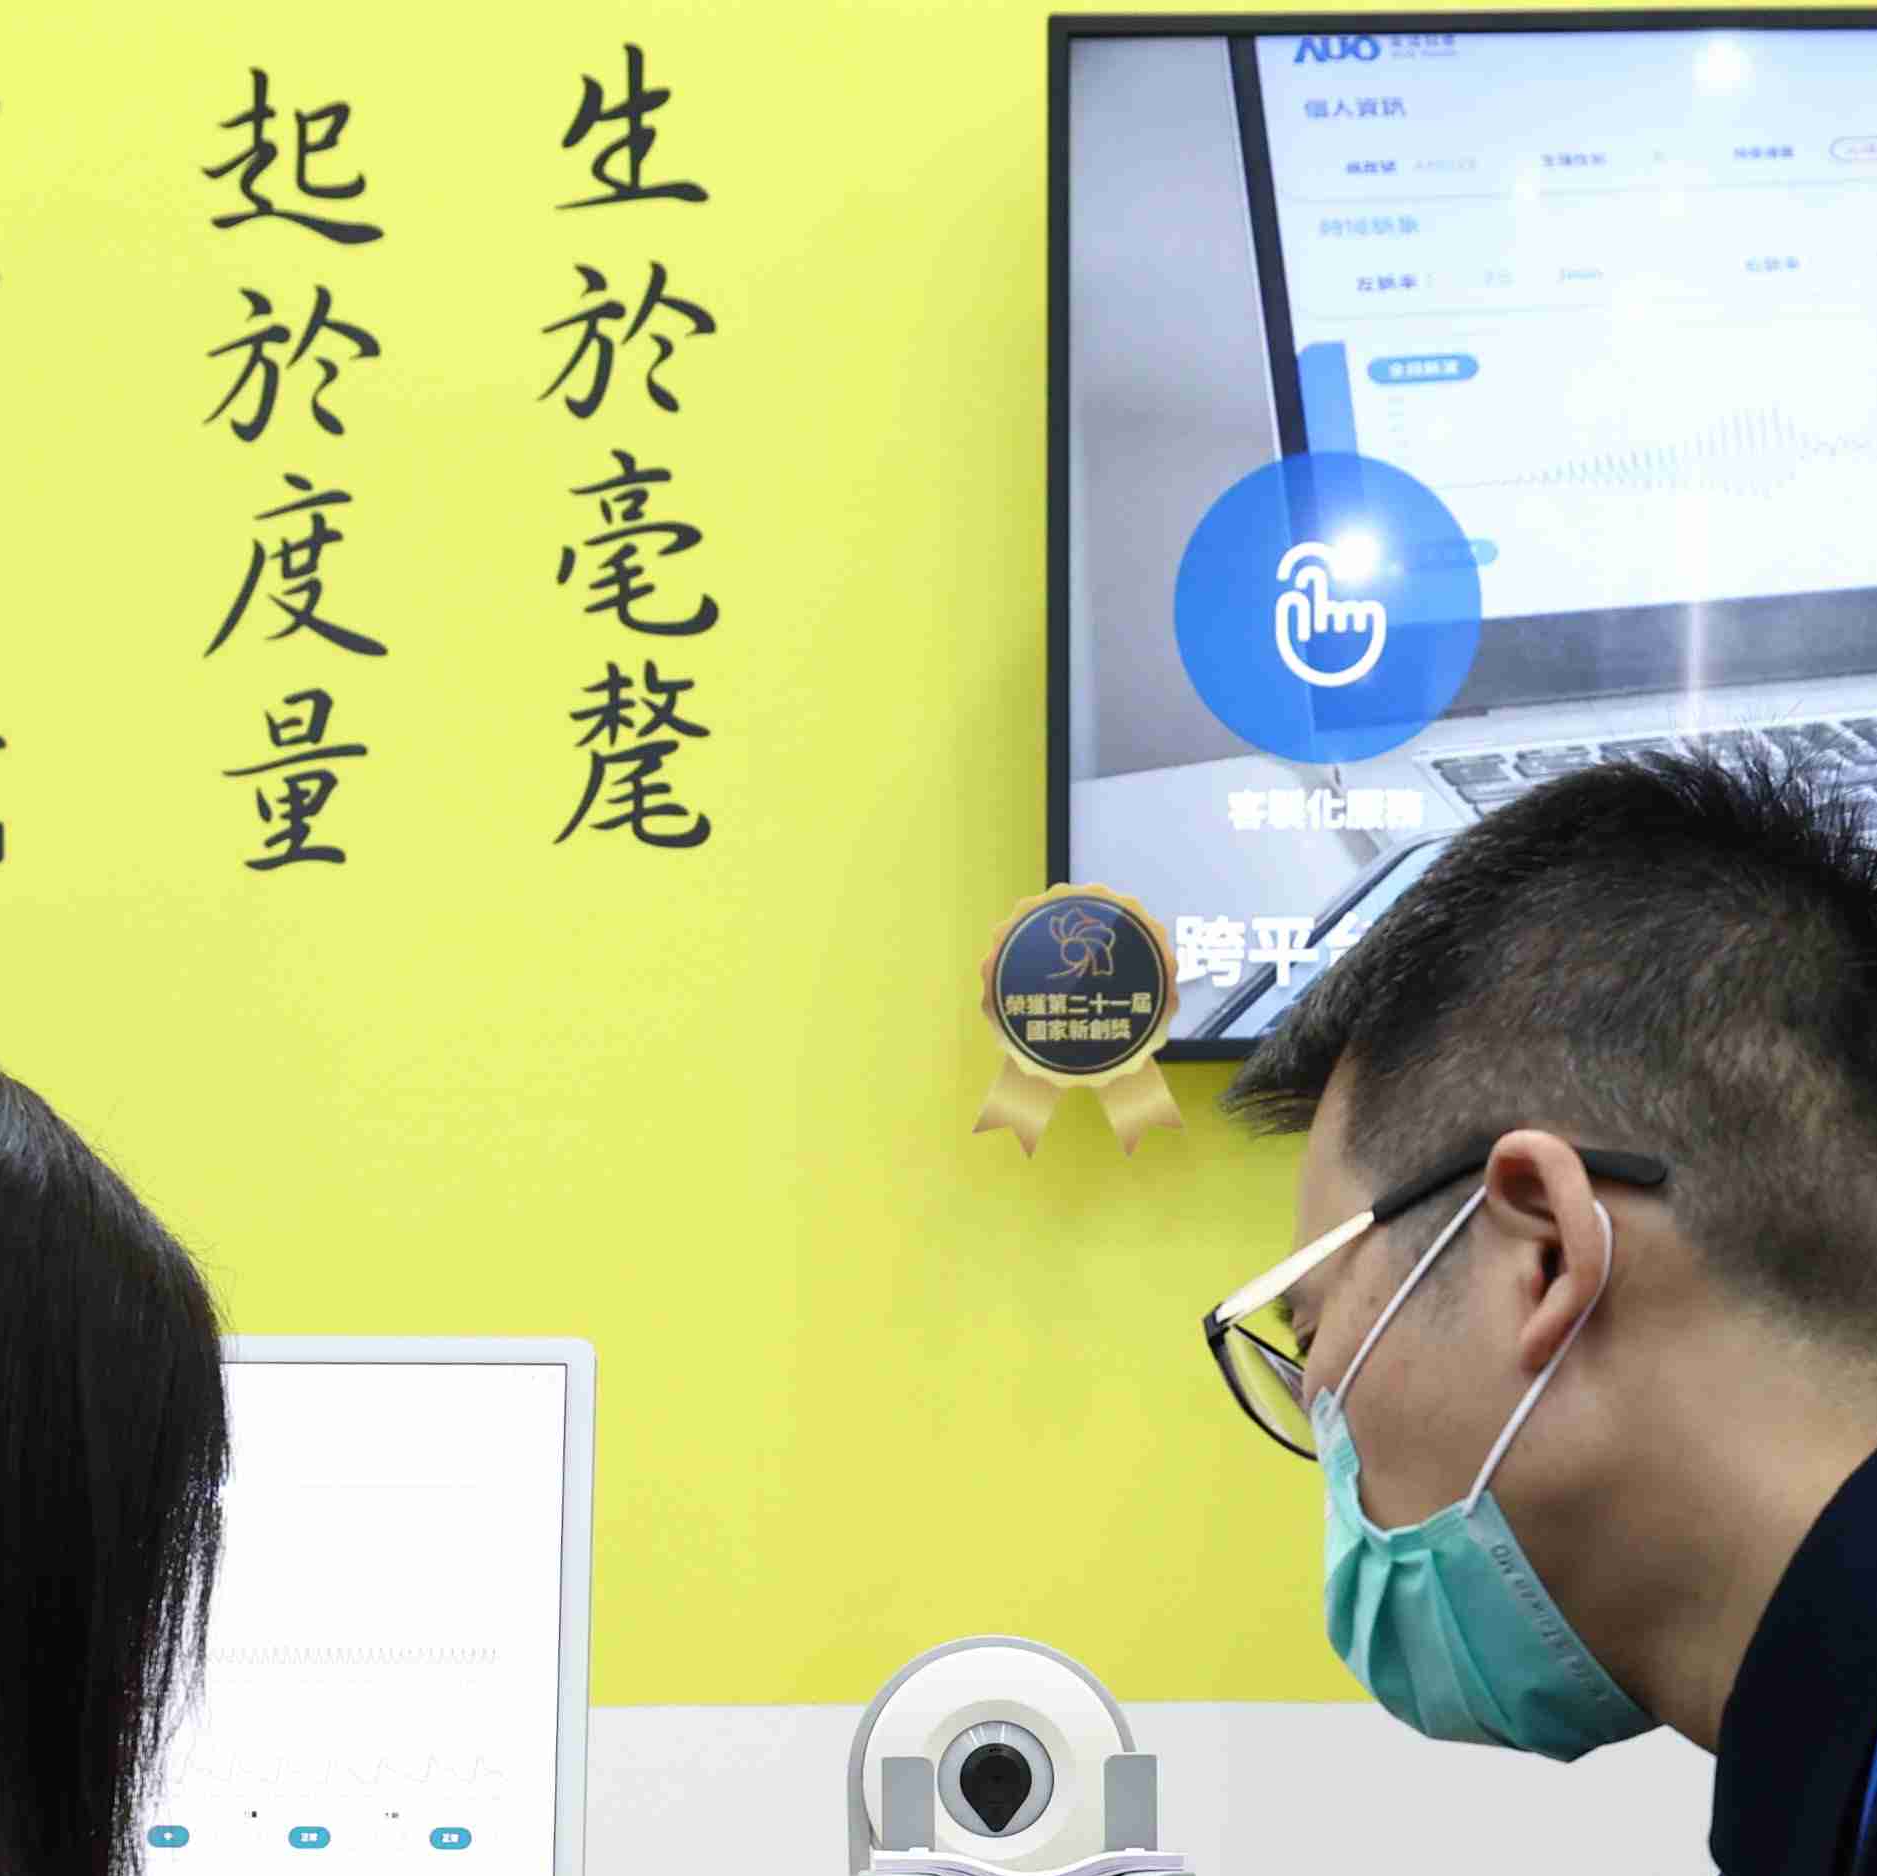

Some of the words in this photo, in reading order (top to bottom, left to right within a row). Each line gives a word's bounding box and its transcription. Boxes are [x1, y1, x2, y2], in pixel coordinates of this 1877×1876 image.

[201, 67, 388, 870] 起於度量
[1004, 992, 1152, 1015] 榮獲第二十一屆
